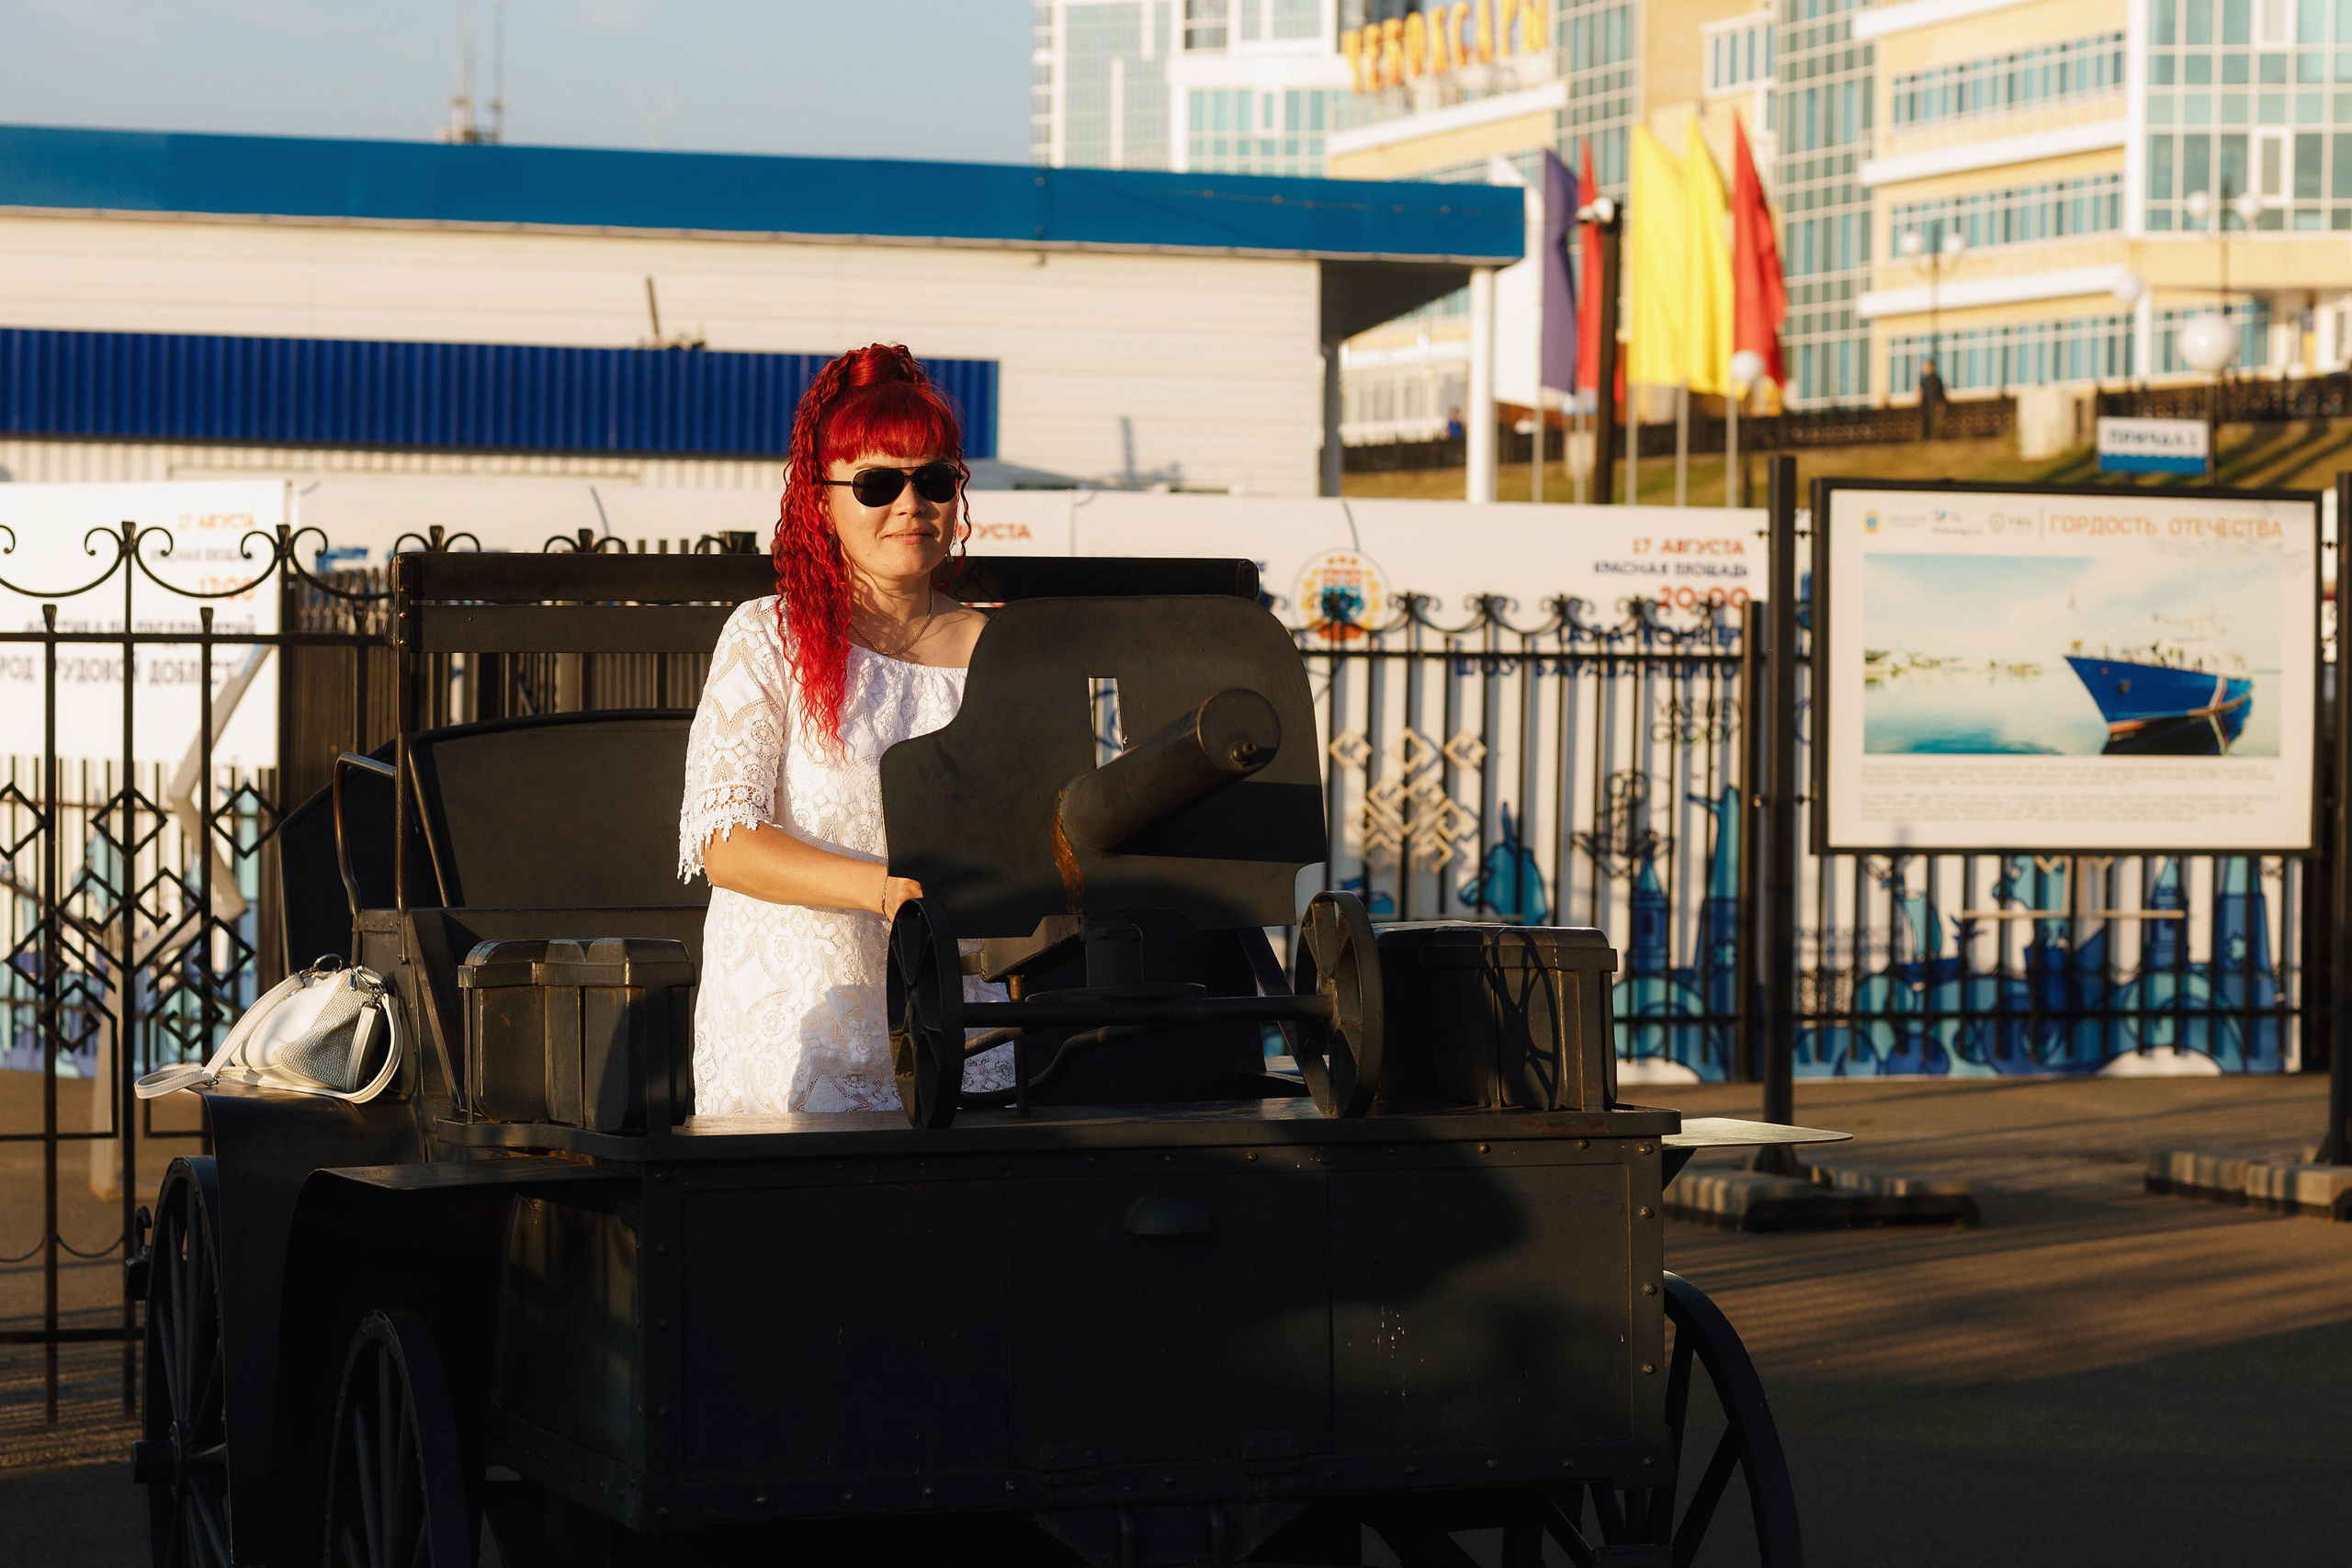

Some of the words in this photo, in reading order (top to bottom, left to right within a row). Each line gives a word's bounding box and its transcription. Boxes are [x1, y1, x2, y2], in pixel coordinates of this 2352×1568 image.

[198, 512, 255, 529] АВГУСТА
[2049, 514, 2158, 536] ГОРДОСТЬ
[2167, 517, 2284, 538] ОТЕЧЕСТВА
[1633, 537, 1651, 554] 17
[1661, 539, 1745, 555] АВГУСТА
[1594, 561, 1668, 576] КРАСНАЯ
[1676, 562, 1747, 577] ПЛОЩАДЬ
[1658, 585, 1749, 609] 20:00
[1559, 621, 1744, 646] АЛА-КОНЦЕР
[44, 650, 140, 683] РУДОВОЙ
[1535, 656, 1741, 679] БАРАБАНЩИО
